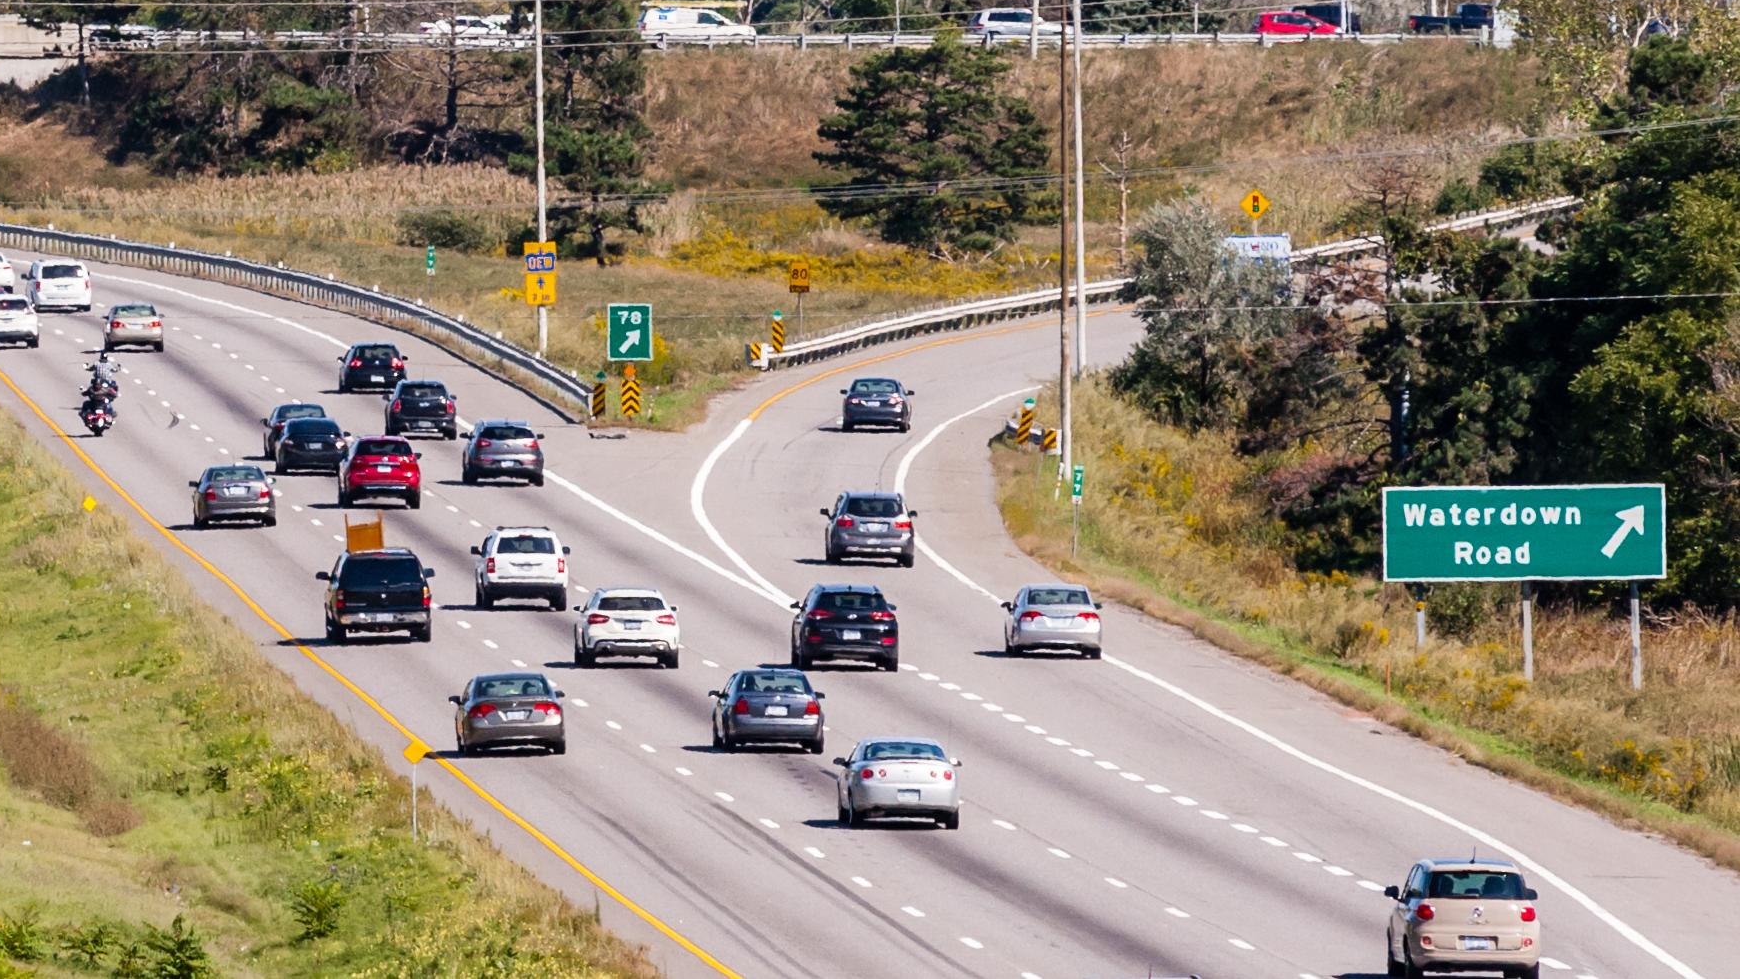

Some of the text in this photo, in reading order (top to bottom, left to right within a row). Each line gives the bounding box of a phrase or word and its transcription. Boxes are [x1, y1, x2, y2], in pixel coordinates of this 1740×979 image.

[792, 269, 807, 279] 80
[617, 311, 642, 324] 78
[1074, 473, 1082, 492] 77
[1404, 503, 1581, 526] Waterdown
[1454, 541, 1530, 565] Road
